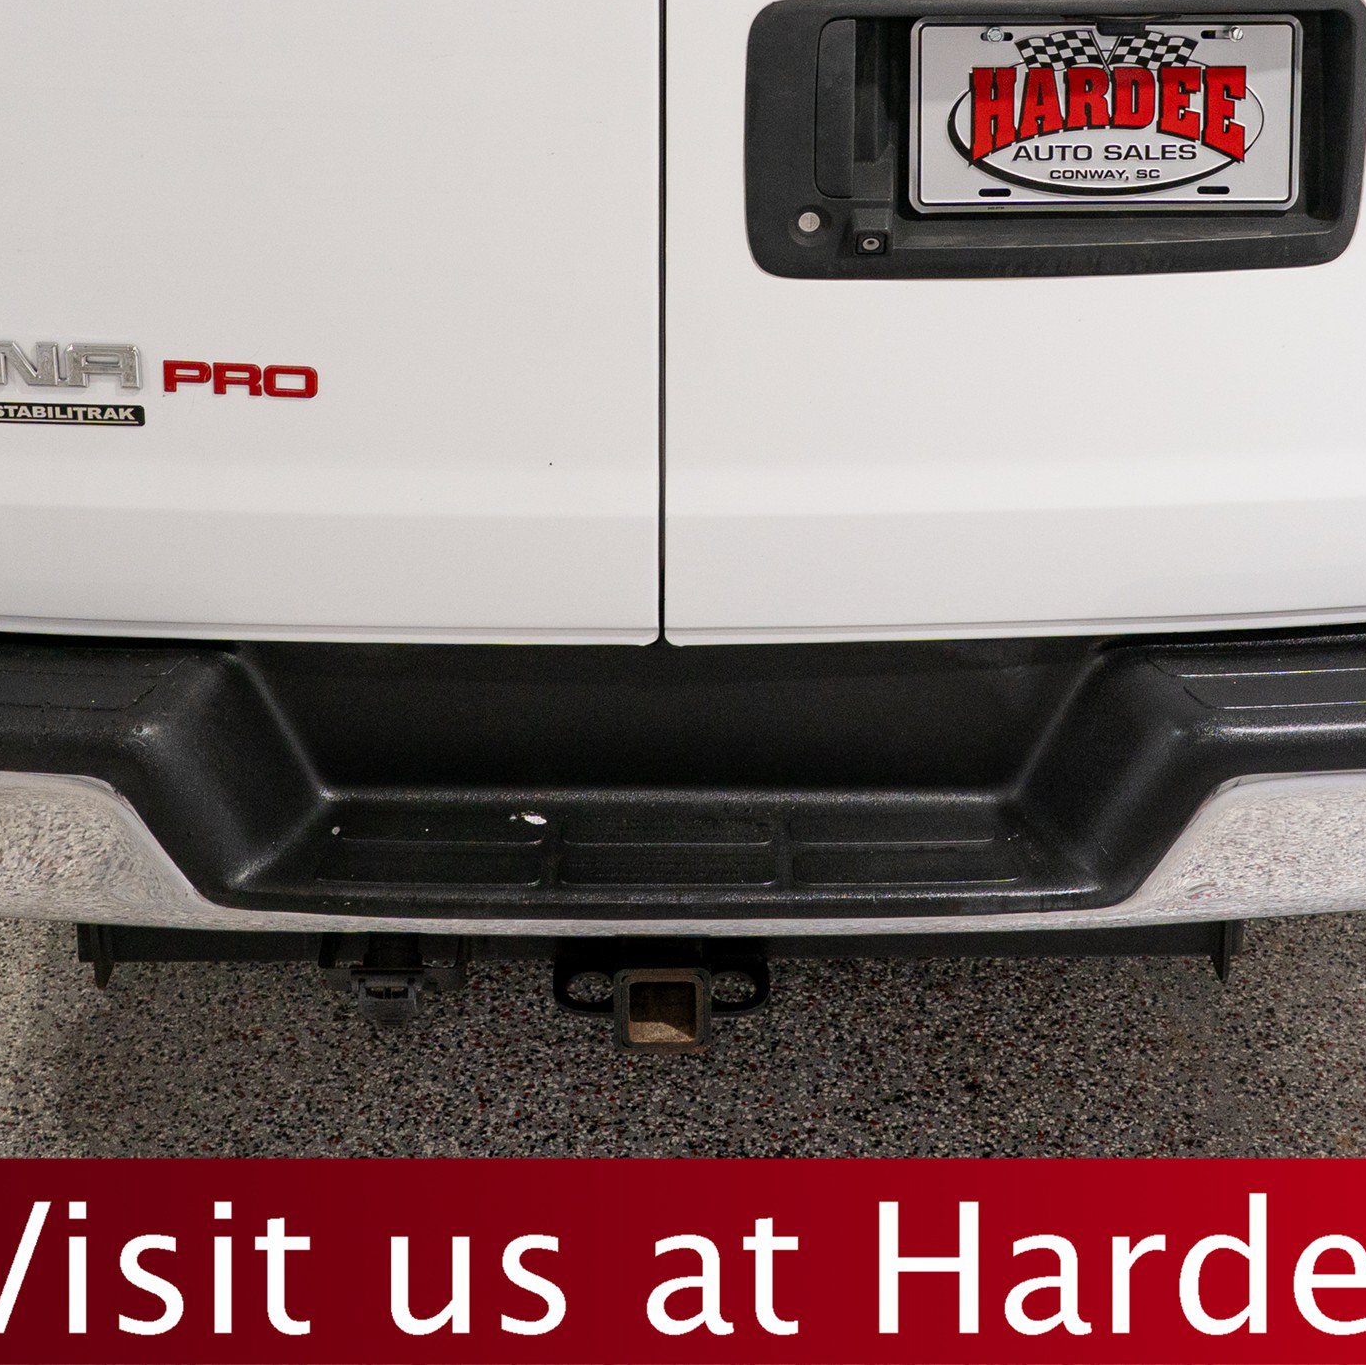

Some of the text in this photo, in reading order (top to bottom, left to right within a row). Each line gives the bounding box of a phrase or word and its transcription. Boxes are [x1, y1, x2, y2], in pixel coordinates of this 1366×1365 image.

[968, 65, 1246, 165] HARDEE
[1012, 142, 1198, 162] AUTO SALES
[1049, 167, 1161, 182] CONWAY, SC
[162, 358, 319, 399] PRO
